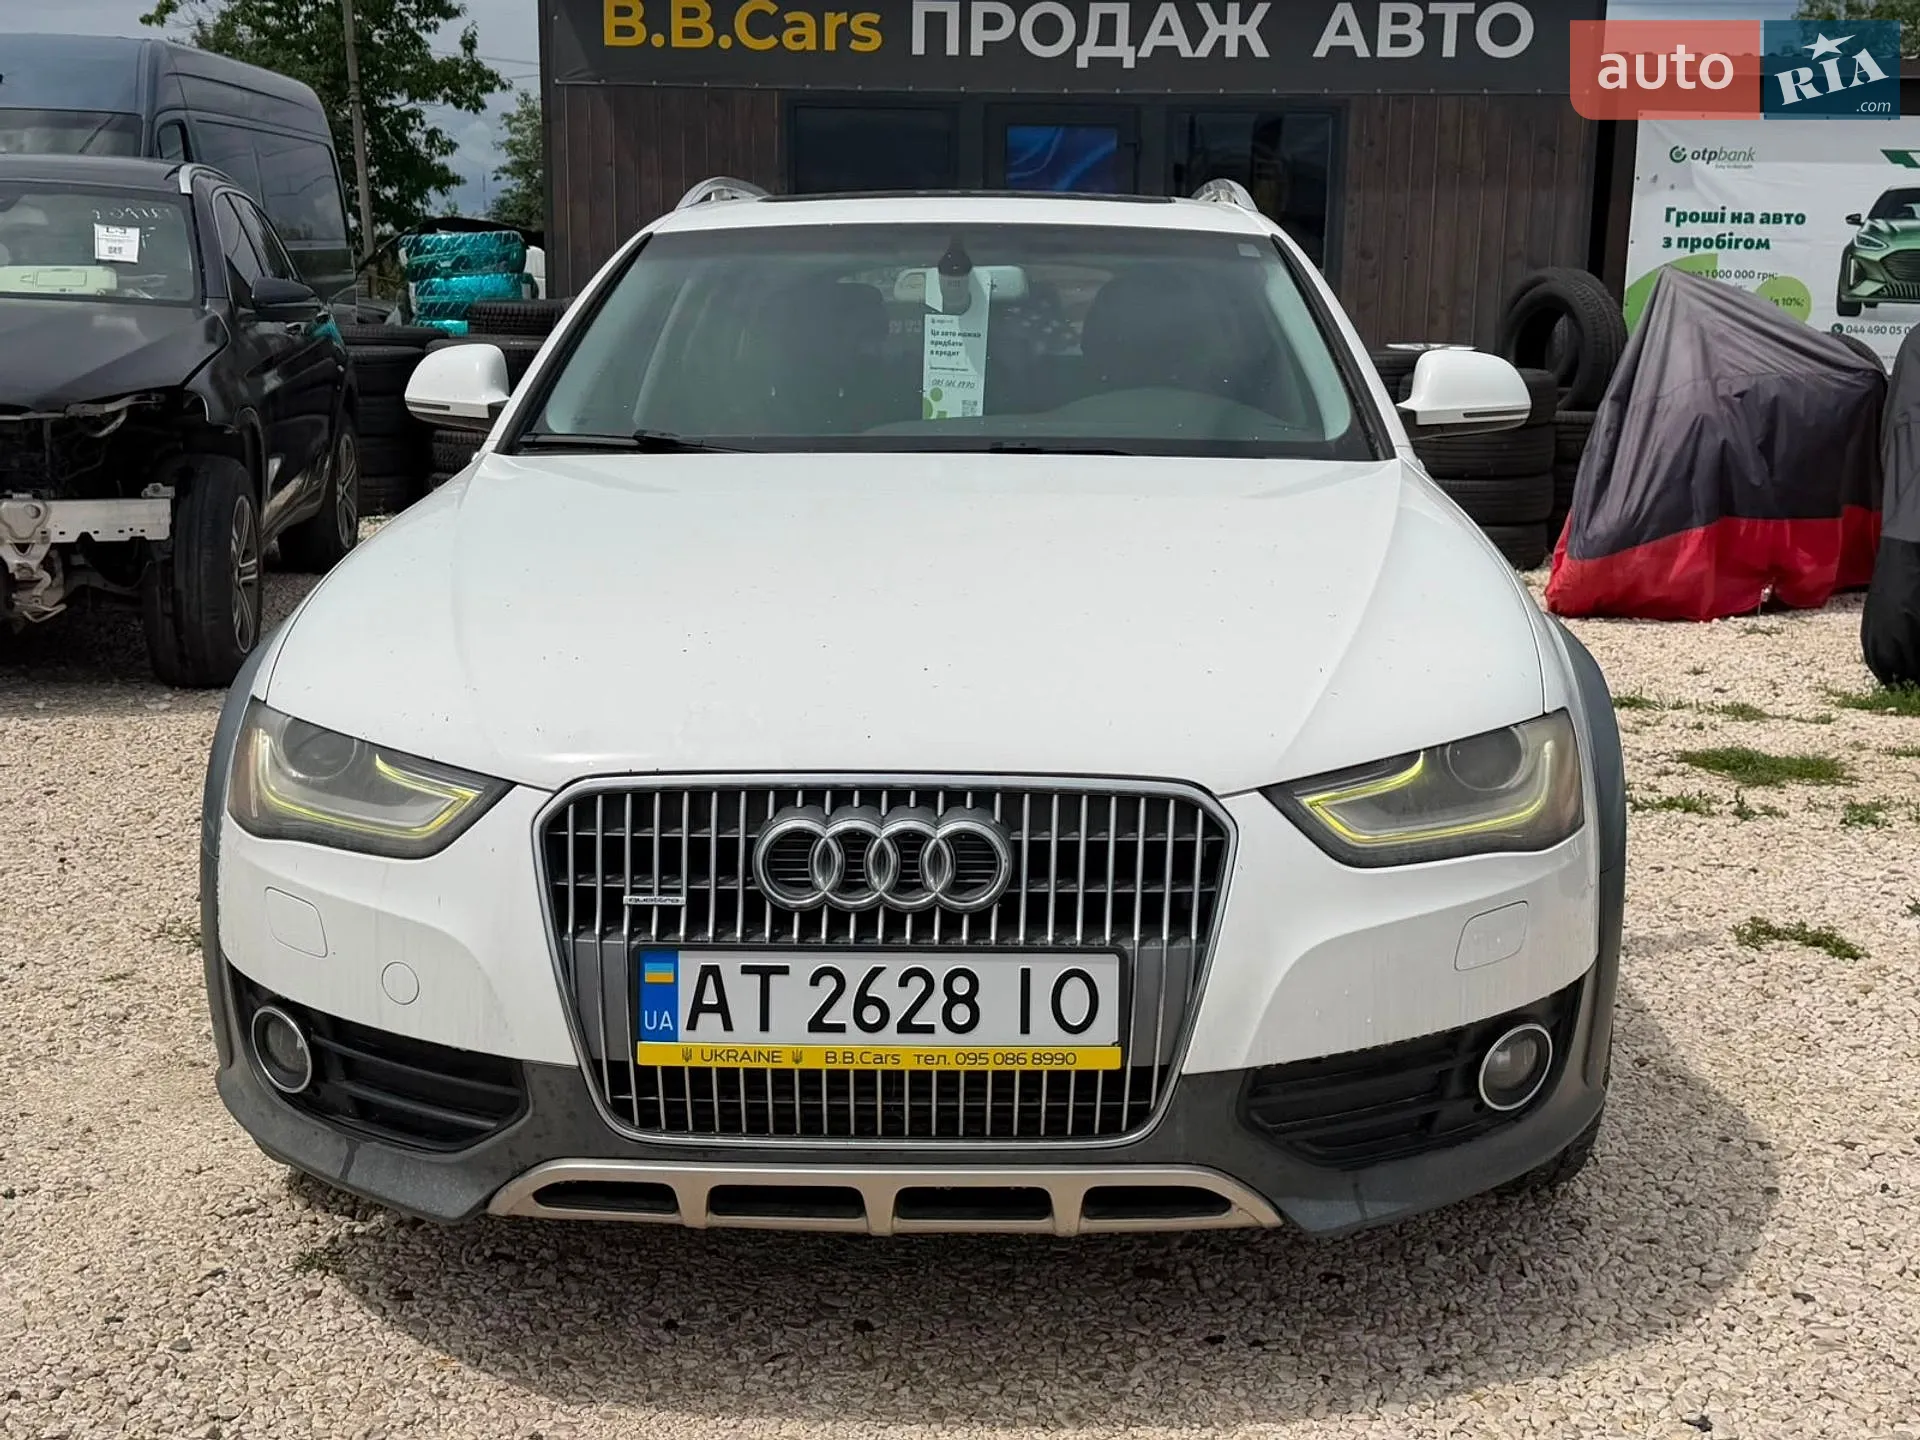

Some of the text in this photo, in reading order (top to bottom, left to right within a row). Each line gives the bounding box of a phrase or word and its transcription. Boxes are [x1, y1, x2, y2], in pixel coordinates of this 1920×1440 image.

[603, 0, 883, 51] B.B.Cars
[911, 1, 1534, 68] ПРОДАЖ АВТО
[1691, 146, 1755, 164] otpbank
[1664, 205, 1806, 228] Гроші на авто
[1662, 231, 1770, 253] з пробігом
[1867, 325, 1888, 335] 490
[686, 963, 790, 1032] AT
[807, 964, 981, 1034] 2628
[644, 1011, 673, 1031] UA
[700, 1049, 782, 1064] UKRAINE
[825, 1051, 901, 1065] B.B.Cars
[955, 1052, 989, 1066] 095
[993, 1052, 1029, 1066] 086
[1032, 1052, 1077, 1066] 8990
